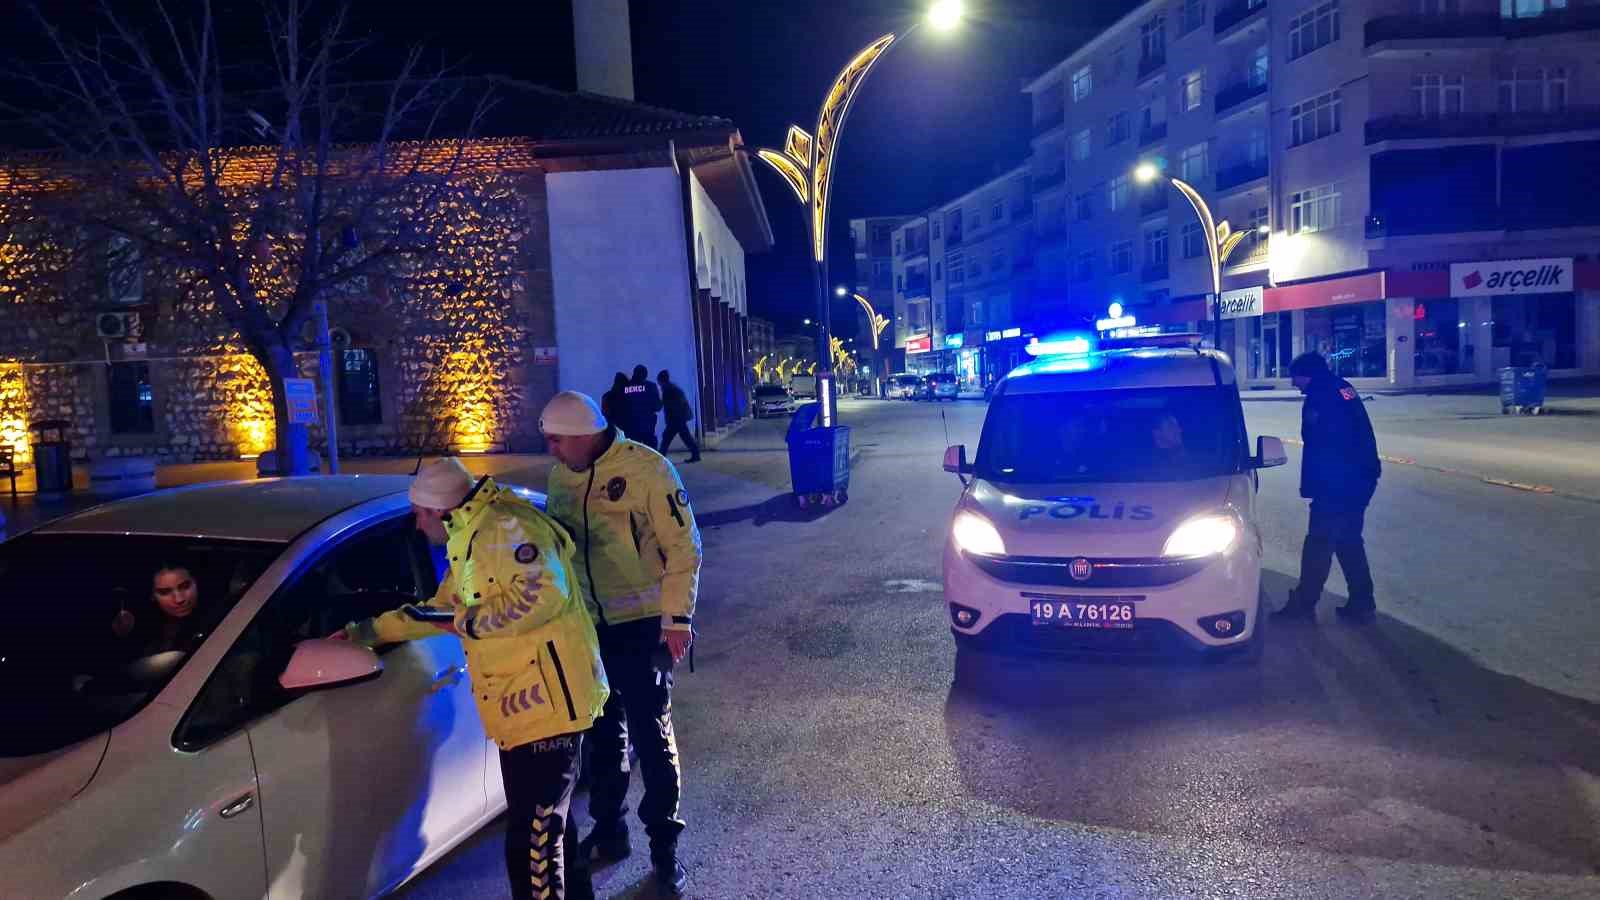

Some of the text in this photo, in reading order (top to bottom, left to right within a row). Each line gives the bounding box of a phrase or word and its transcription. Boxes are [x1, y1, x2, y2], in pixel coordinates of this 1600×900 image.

[1486, 265, 1563, 292] arçelik
[1033, 603, 1132, 621] 19 A 76126
